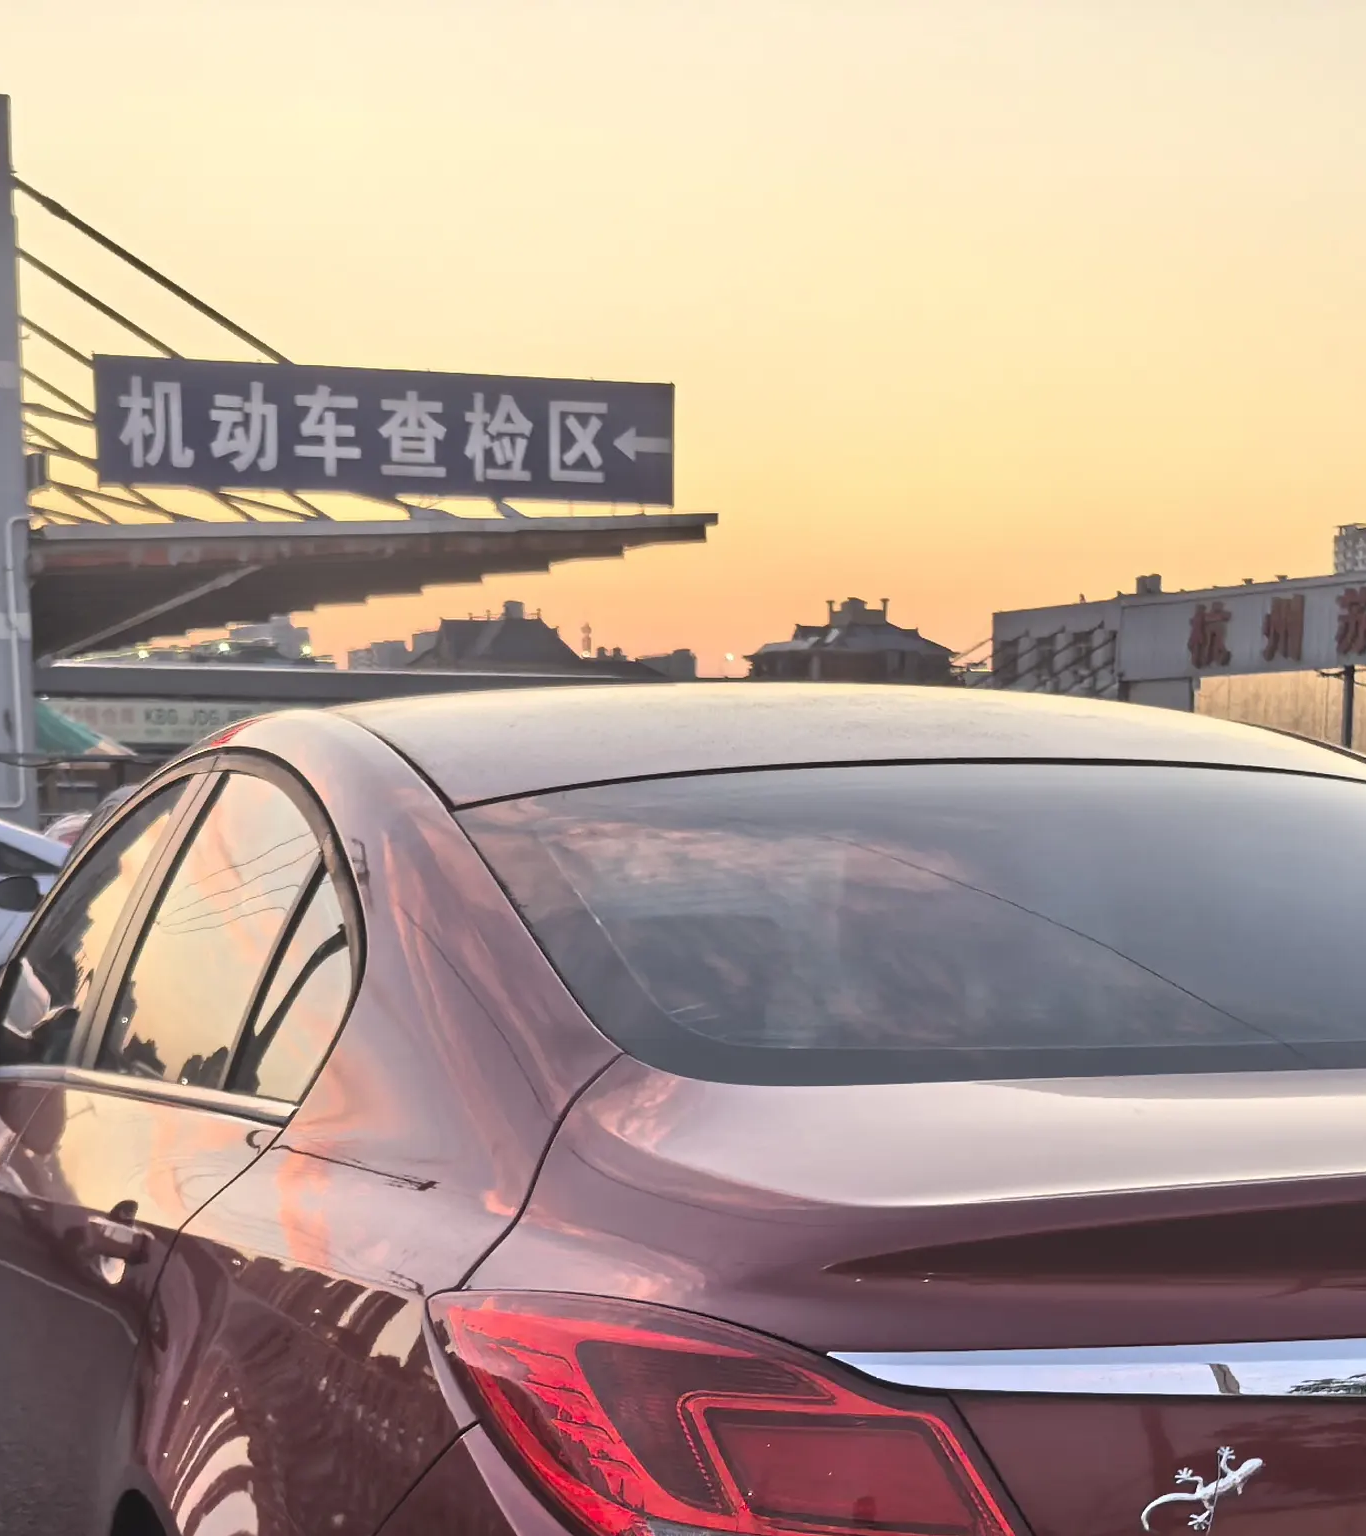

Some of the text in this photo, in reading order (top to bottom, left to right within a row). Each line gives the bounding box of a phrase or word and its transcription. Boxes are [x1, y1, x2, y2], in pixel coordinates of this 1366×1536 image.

[118, 375, 609, 483] 机动车查检区
